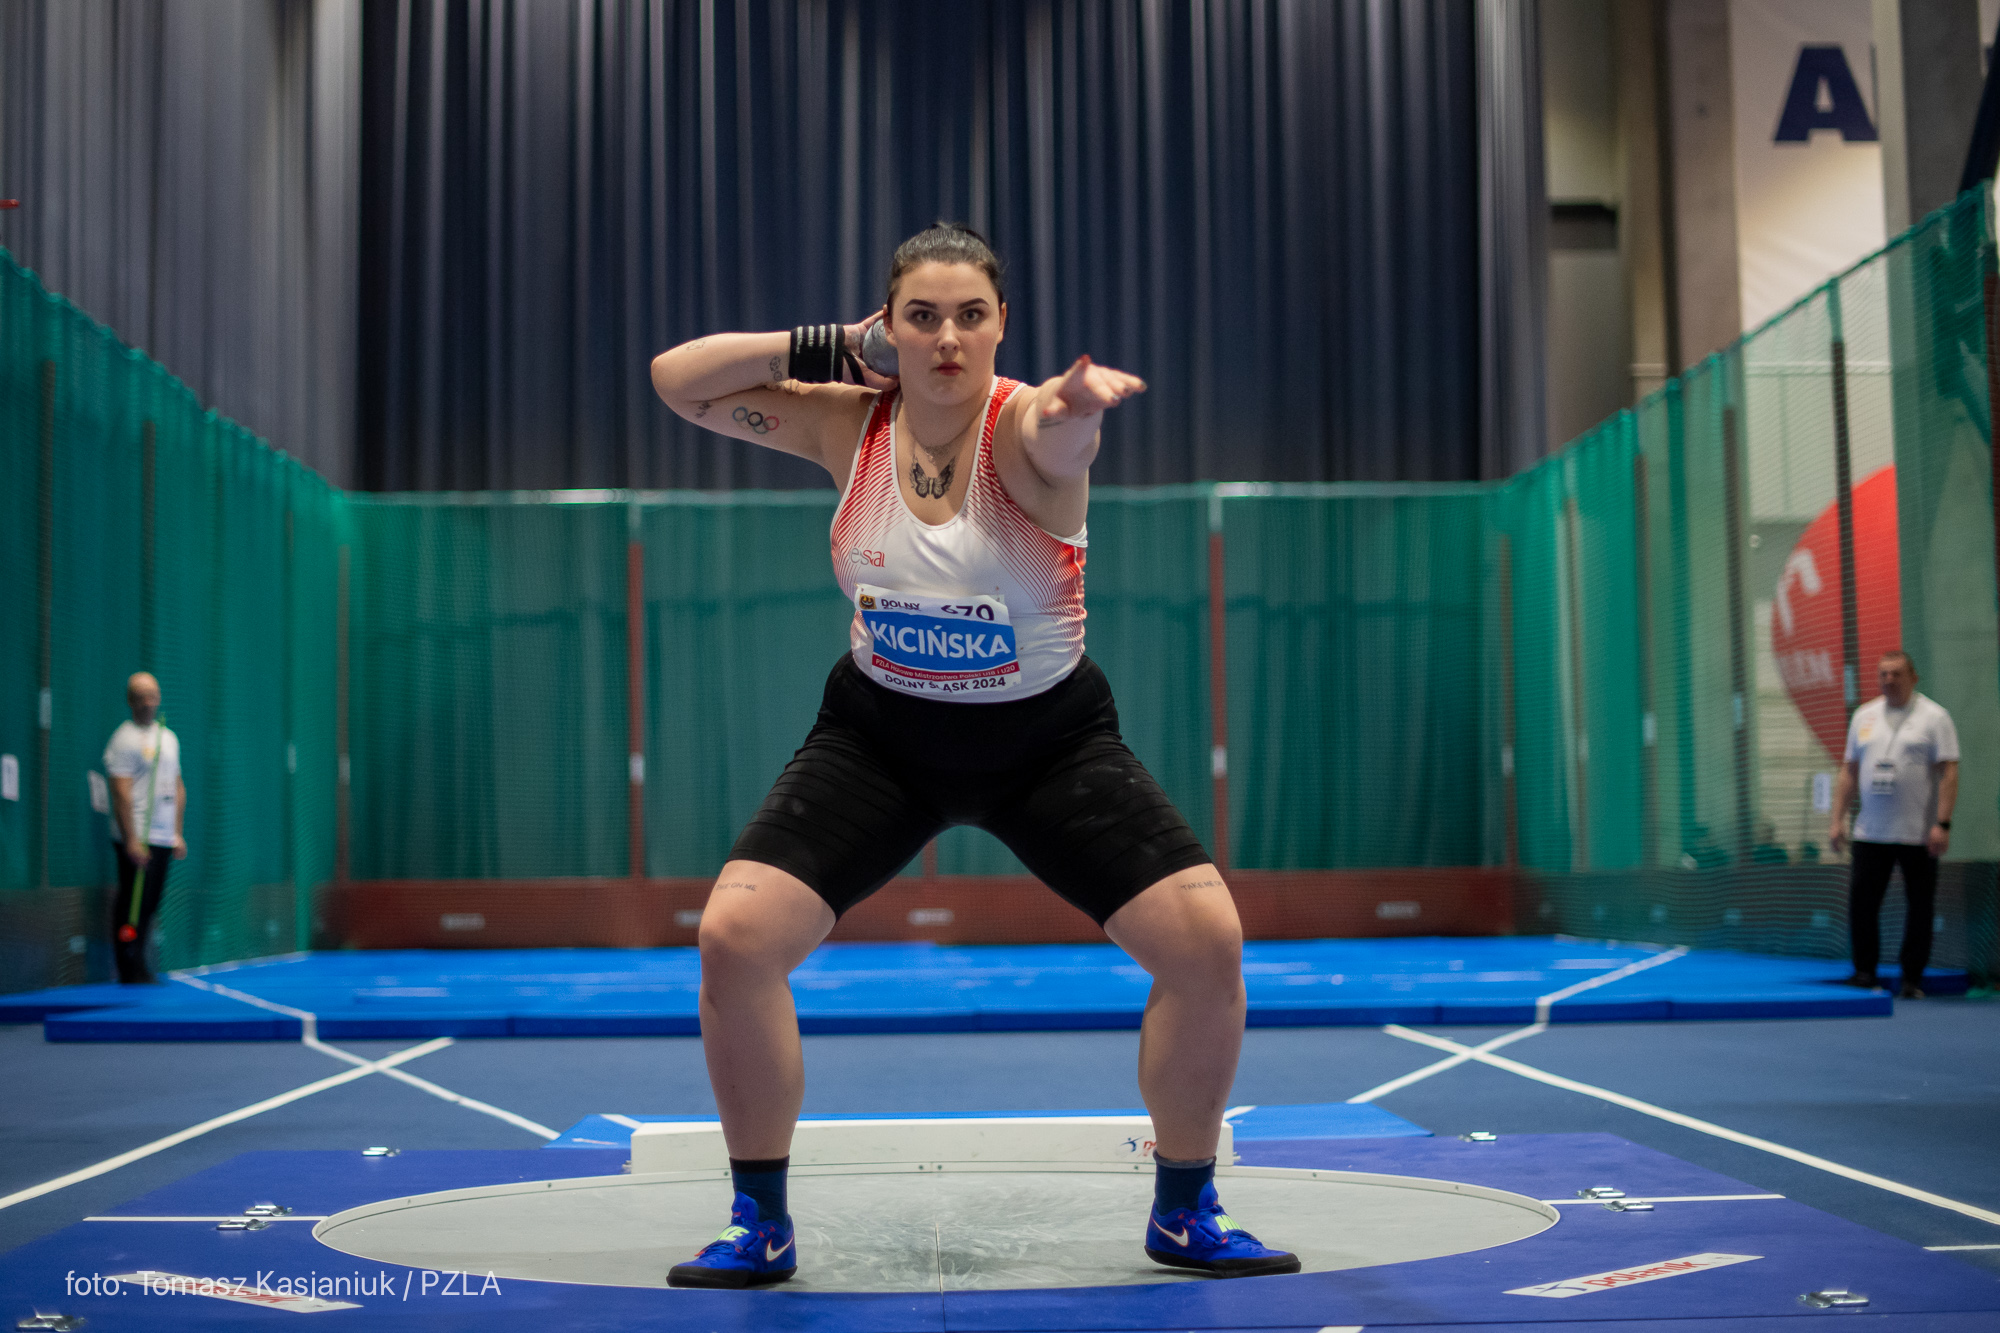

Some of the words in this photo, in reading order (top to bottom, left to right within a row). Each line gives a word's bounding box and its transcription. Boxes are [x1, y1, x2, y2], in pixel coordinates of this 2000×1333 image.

[1773, 44, 1879, 143] A
[881, 598, 920, 610] DOLNY
[870, 620, 1011, 659] KICIŃSKA
[875, 658, 889, 668] PZLA
[915, 672, 958, 680] Mistrzostwa
[1000, 664, 1016, 674] U20
[885, 674, 925, 689] DOLNY
[972, 676, 1006, 689] 2024
[1582, 1261, 1709, 1288] polanik
